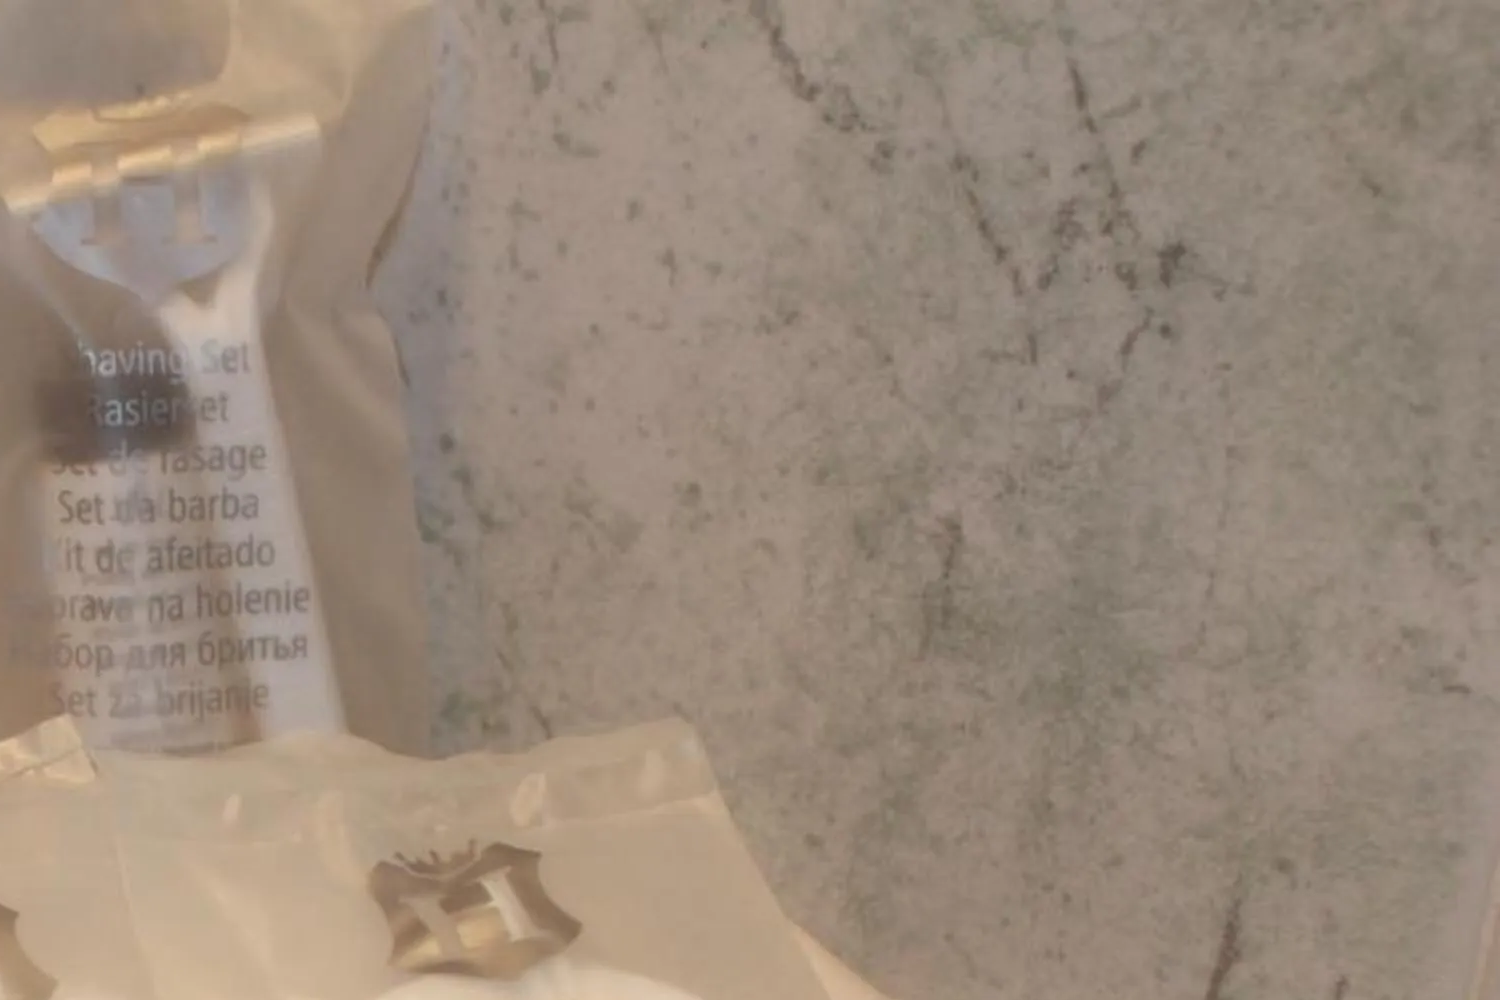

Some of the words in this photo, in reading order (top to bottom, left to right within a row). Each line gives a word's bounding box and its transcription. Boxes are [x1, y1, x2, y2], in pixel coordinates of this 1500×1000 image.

[73, 338, 187, 385] having
[200, 337, 250, 375] Set
[158, 443, 269, 481] rasage
[57, 488, 105, 525] Set
[167, 483, 261, 522] barba
[53, 536, 85, 575] it
[94, 536, 136, 575] de
[146, 533, 277, 573] afeitado
[147, 594, 184, 625] na
[196, 579, 311, 620] holenie
[196, 631, 308, 672] бритья
